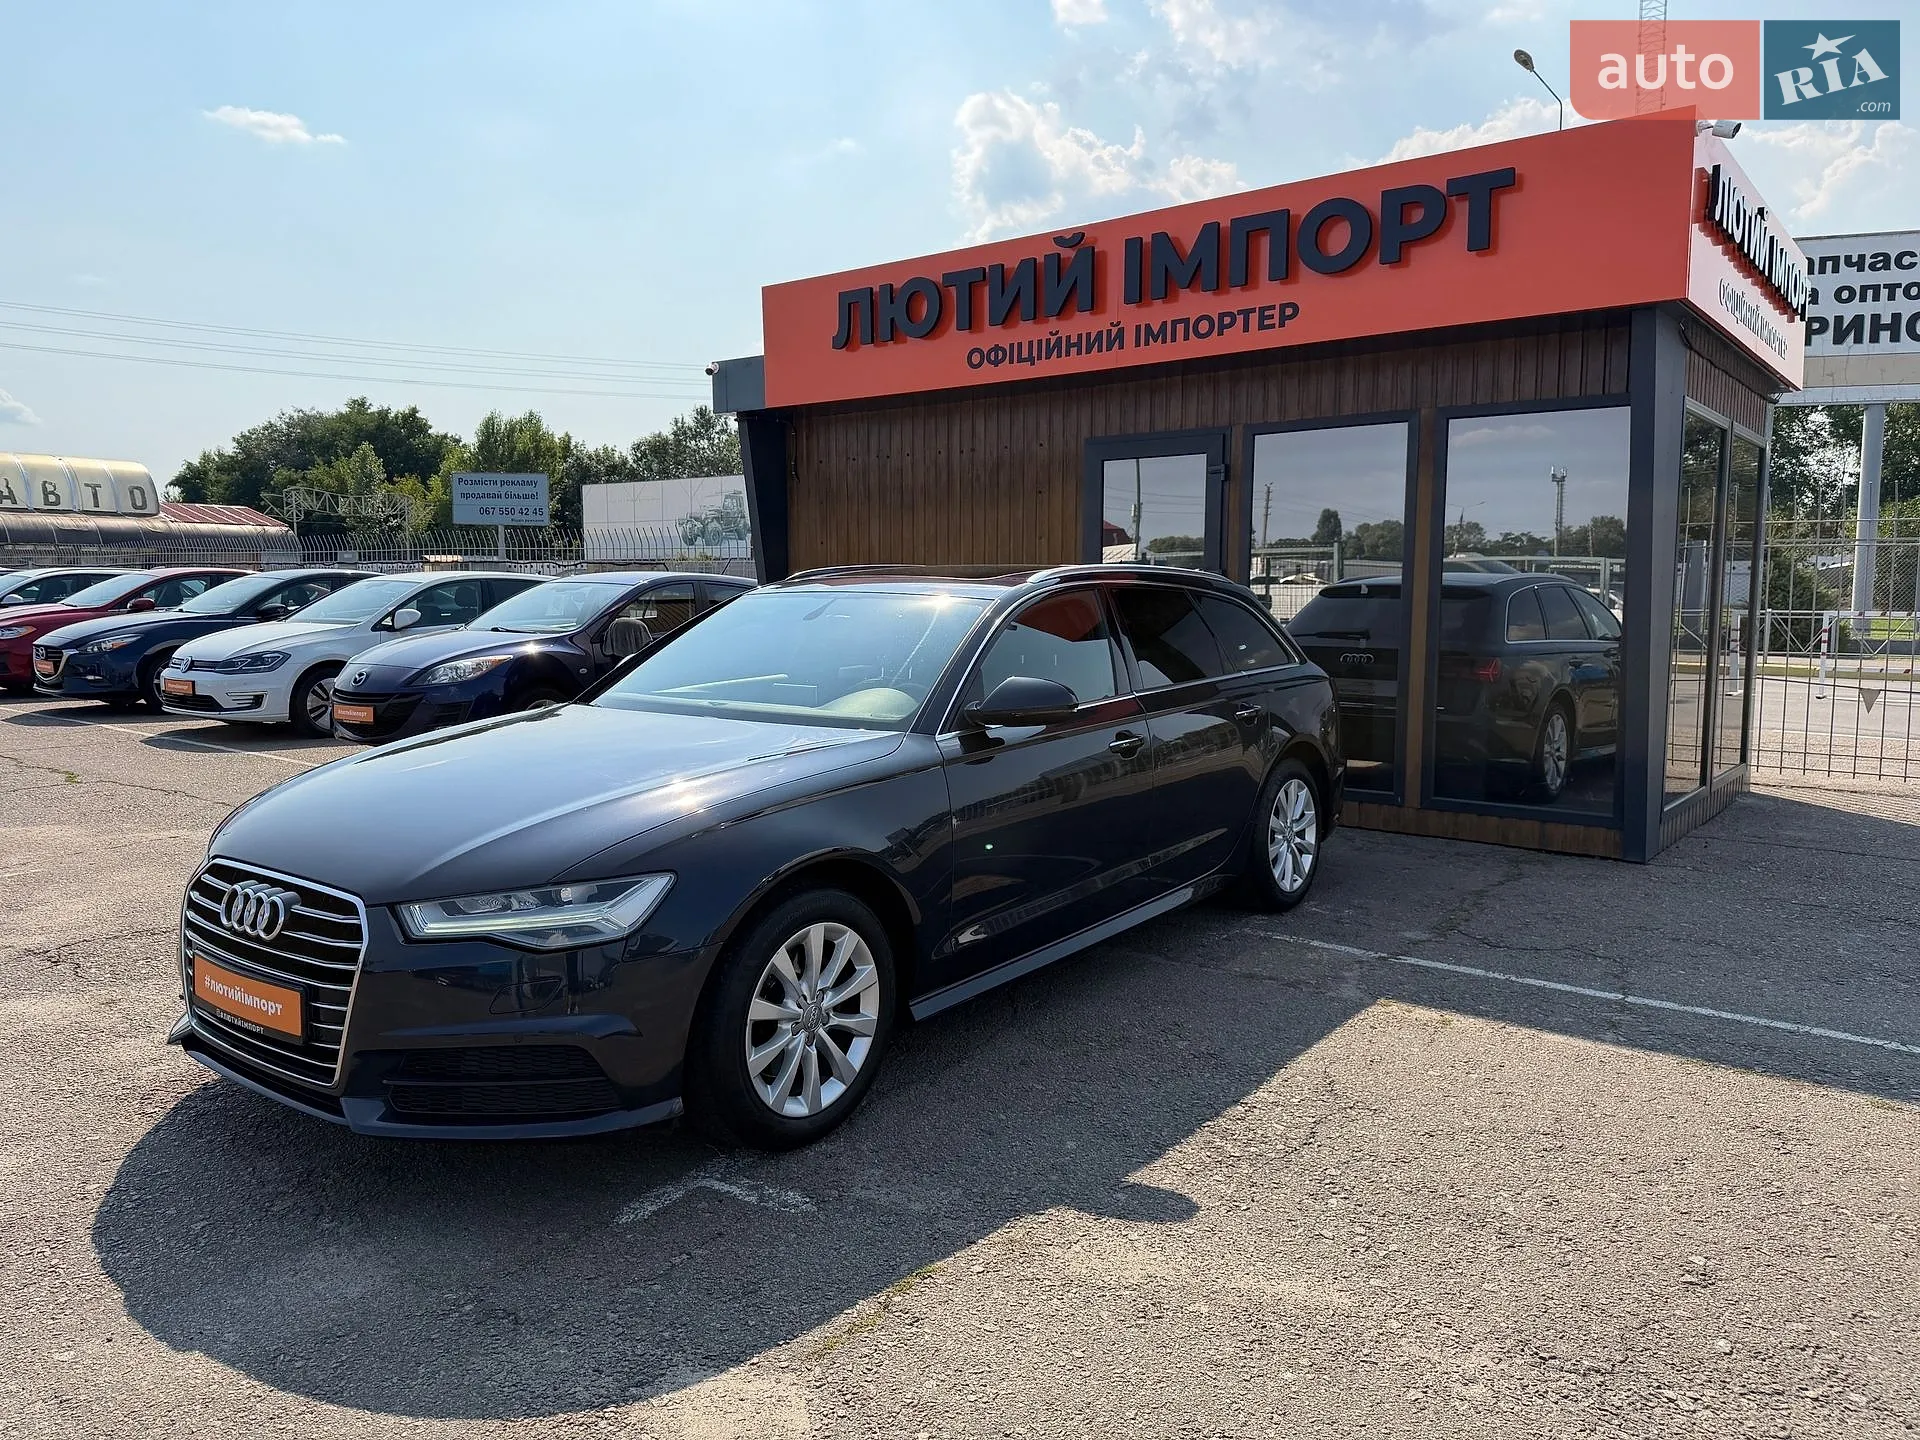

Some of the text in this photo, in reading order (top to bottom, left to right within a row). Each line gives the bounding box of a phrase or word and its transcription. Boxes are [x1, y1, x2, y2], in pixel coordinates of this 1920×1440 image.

[1708, 164, 1769, 277] ЛЮТИЙ
[832, 166, 1516, 350] ЛЮТИЙ ІМПОРТ
[966, 302, 1300, 369] ОФІЦІЙНИЙ ІМПОРТЕР
[458, 477, 539, 488] Розмісти рекламу
[460, 491, 539, 500] продавай більше!
[479, 506, 544, 516] 067 550 42 45
[204, 974, 283, 1016] #лютийімпорт
